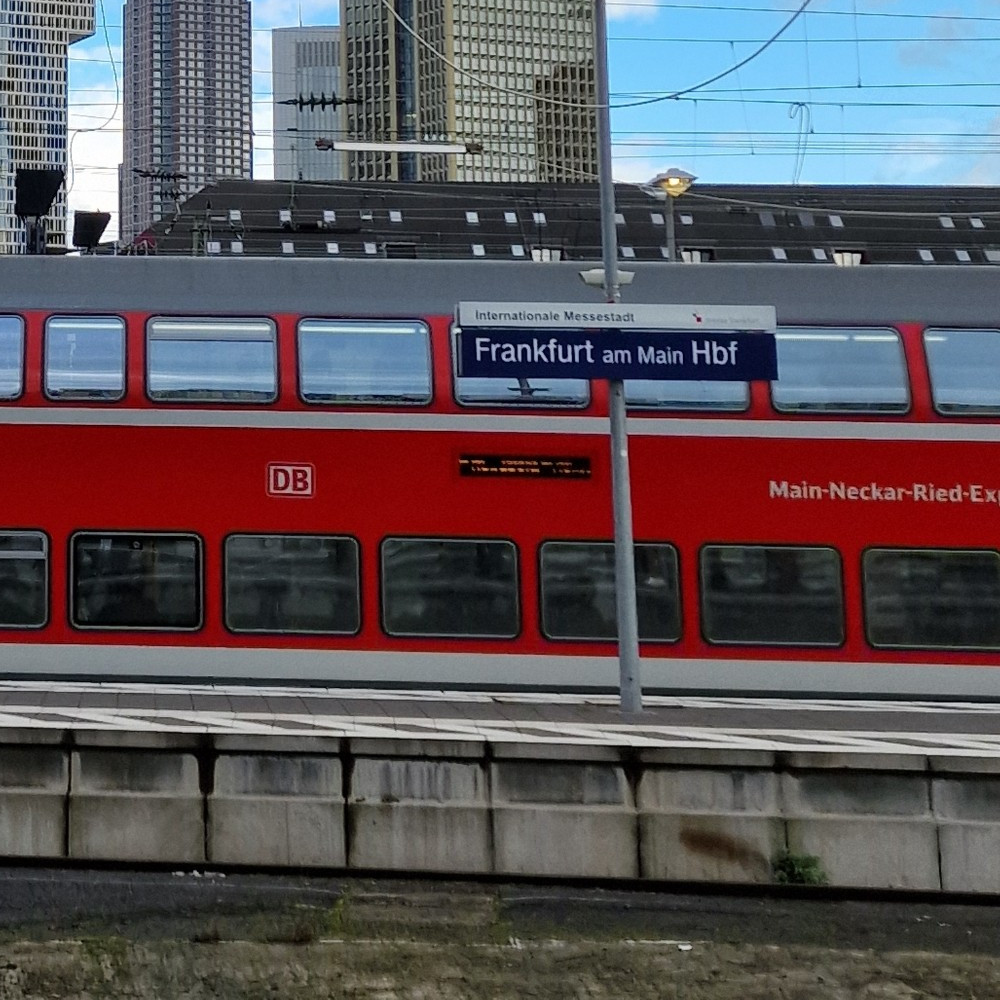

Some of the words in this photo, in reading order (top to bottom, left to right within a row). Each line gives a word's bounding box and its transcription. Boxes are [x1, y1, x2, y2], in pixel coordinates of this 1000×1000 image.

[475, 309, 560, 322] Internationale
[563, 311, 635, 323] Messestadt
[475, 337, 595, 364] Frankfurt
[602, 348, 632, 365] am
[637, 345, 684, 365] Main
[691, 339, 738, 366] Hbf
[270, 466, 311, 494] DB
[768, 479, 1000, 507] Main-Neckar-Ried-Ex
